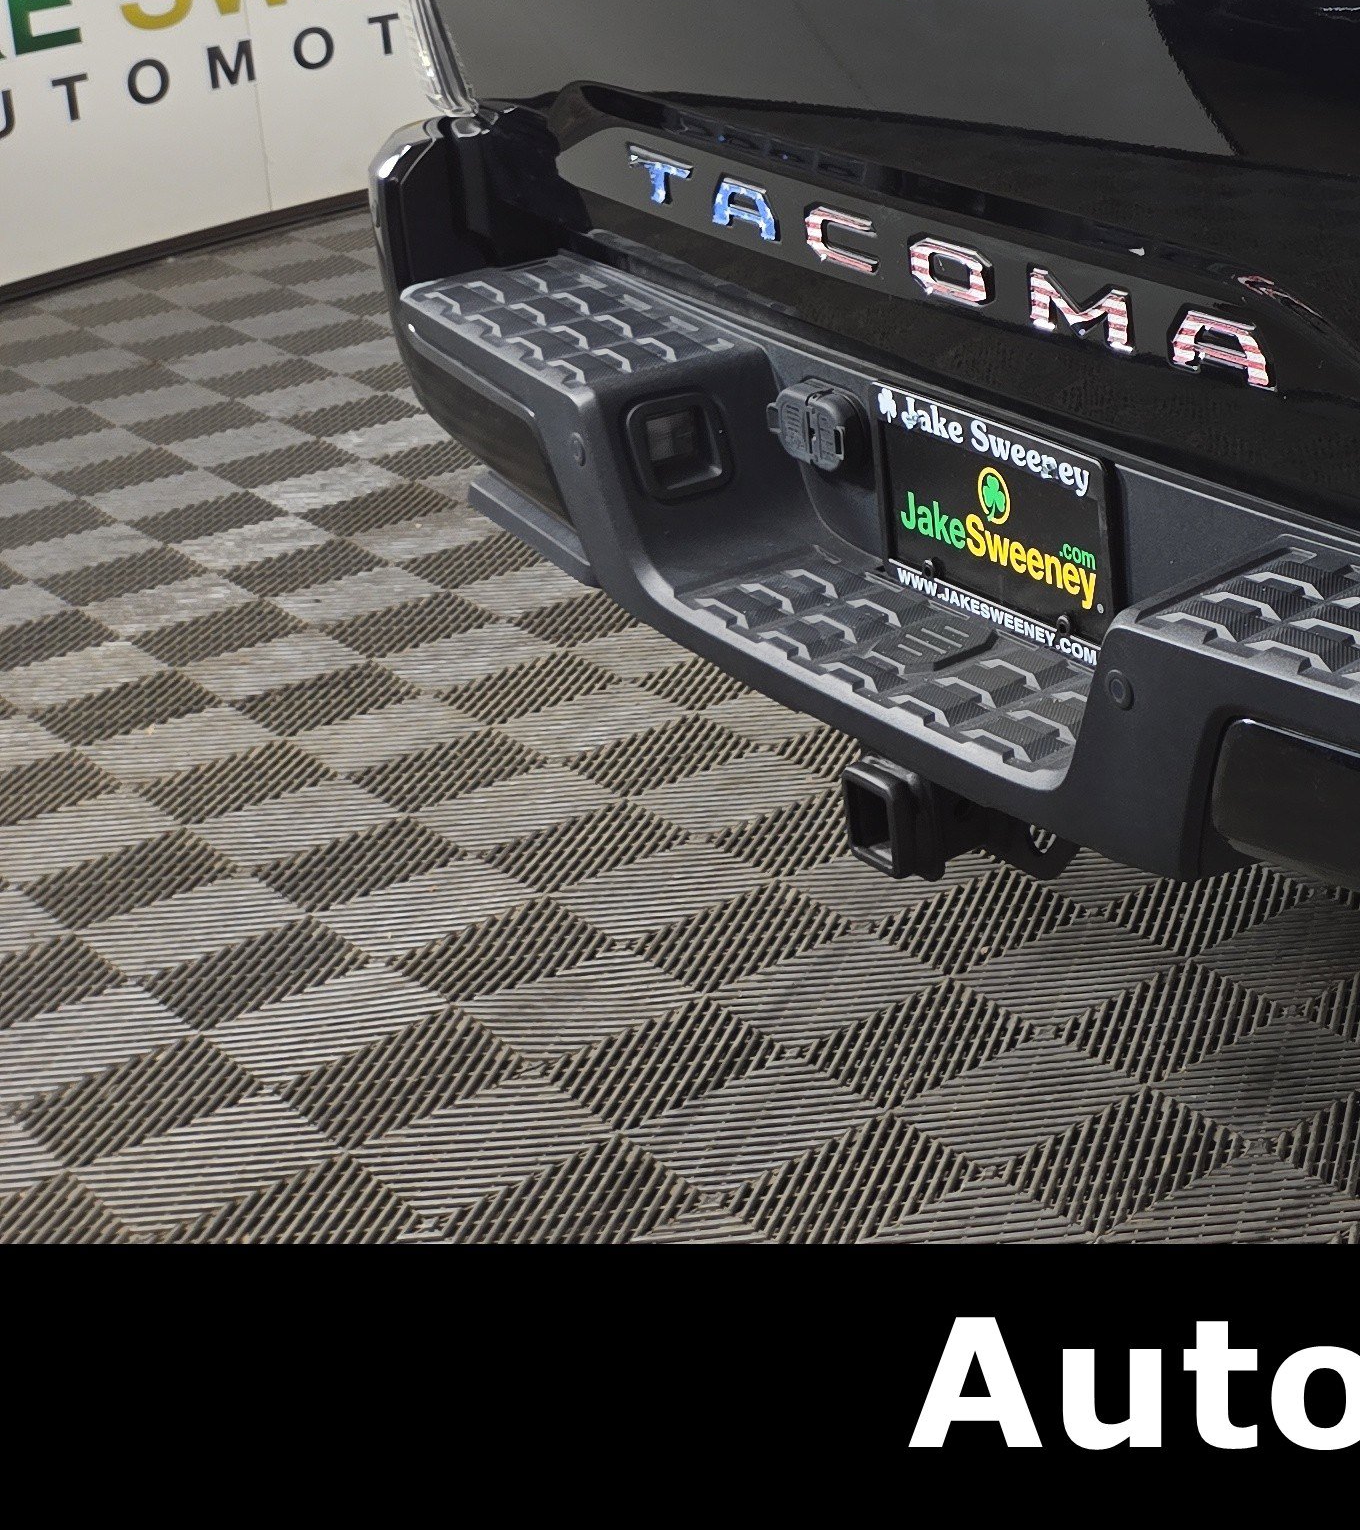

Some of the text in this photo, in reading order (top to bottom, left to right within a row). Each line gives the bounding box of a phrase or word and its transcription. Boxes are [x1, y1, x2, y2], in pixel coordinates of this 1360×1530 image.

[628, 142, 1278, 391] TACOMA
[901, 396, 964, 445] Jake
[970, 419, 1091, 497] Sweeney
[900, 491, 1098, 610] JakeSweeney
[1058, 542, 1097, 571] .com
[896, 567, 1098, 667] WWW.JAKESWEENEY.COM
